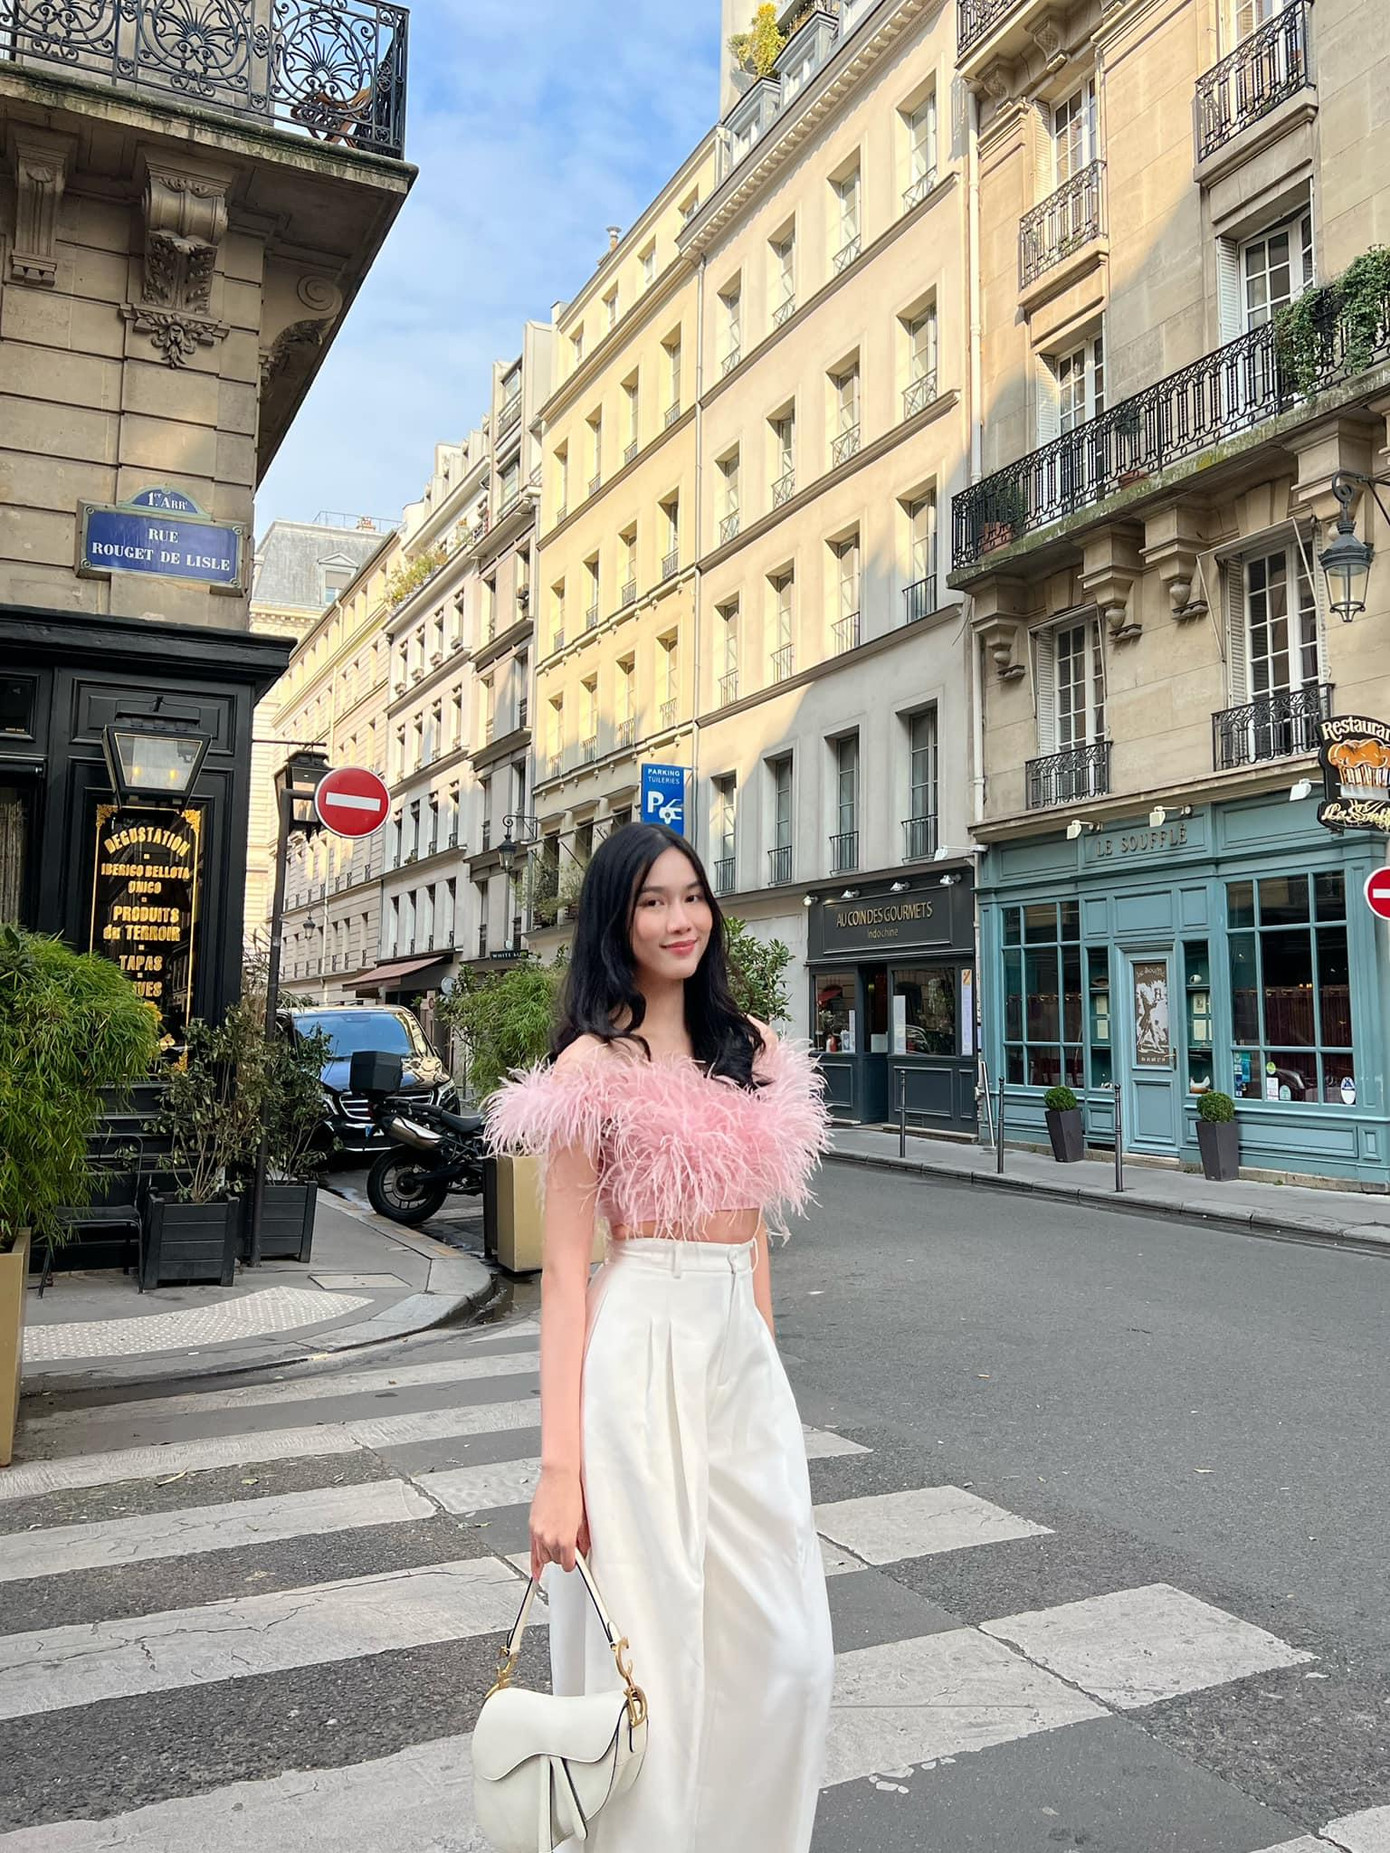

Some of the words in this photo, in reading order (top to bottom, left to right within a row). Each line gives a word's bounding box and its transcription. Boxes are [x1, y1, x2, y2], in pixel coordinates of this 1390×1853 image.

[149, 527, 178, 543] RUE
[91, 541, 154, 561] ROUGET
[160, 551, 180, 564] DE
[186, 554, 230, 571] LISLE
[647, 768, 680, 777] PARKING
[648, 776, 680, 785] TUILERIES
[647, 790, 664, 813] P
[104, 826, 190, 857] DEGUSTATION
[1097, 840, 1112, 857] LE
[101, 863, 144, 877] IBERICO
[144, 865, 190, 879] BELLOTA
[113, 905, 180, 923] PRODUITS
[837, 912, 847, 927] AU
[847, 909, 867, 926] COIN
[867, 907, 883, 924] DES
[883, 901, 933, 922] GOURMETS
[125, 924, 181, 941] TERROIR
[119, 954, 163, 971] TAPAS
